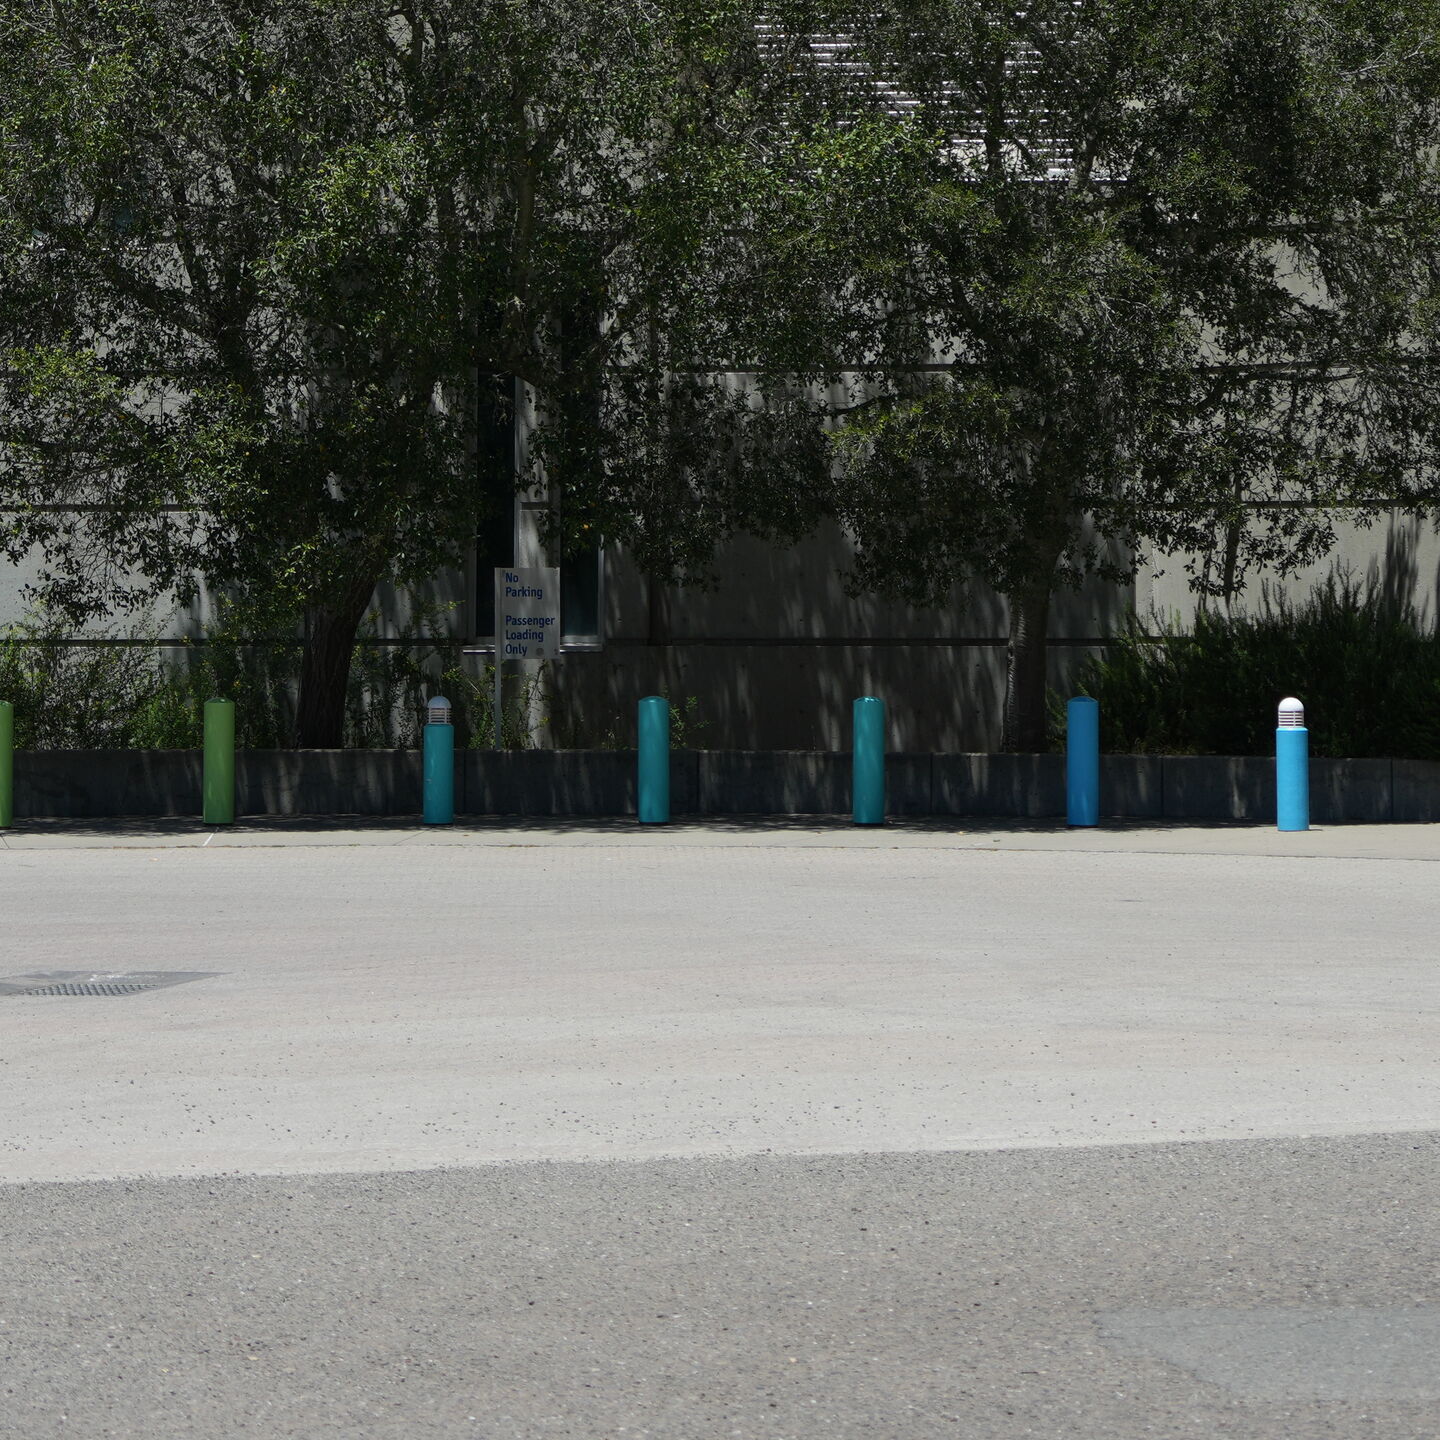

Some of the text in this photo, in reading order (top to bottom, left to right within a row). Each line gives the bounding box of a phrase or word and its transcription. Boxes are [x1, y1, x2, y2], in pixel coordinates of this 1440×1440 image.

[505, 572, 519, 583] No
[505, 586, 543, 600] Parking
[505, 615, 556, 628] Passenger
[505, 629, 544, 643] Loading
[505, 643, 528, 657] Only
